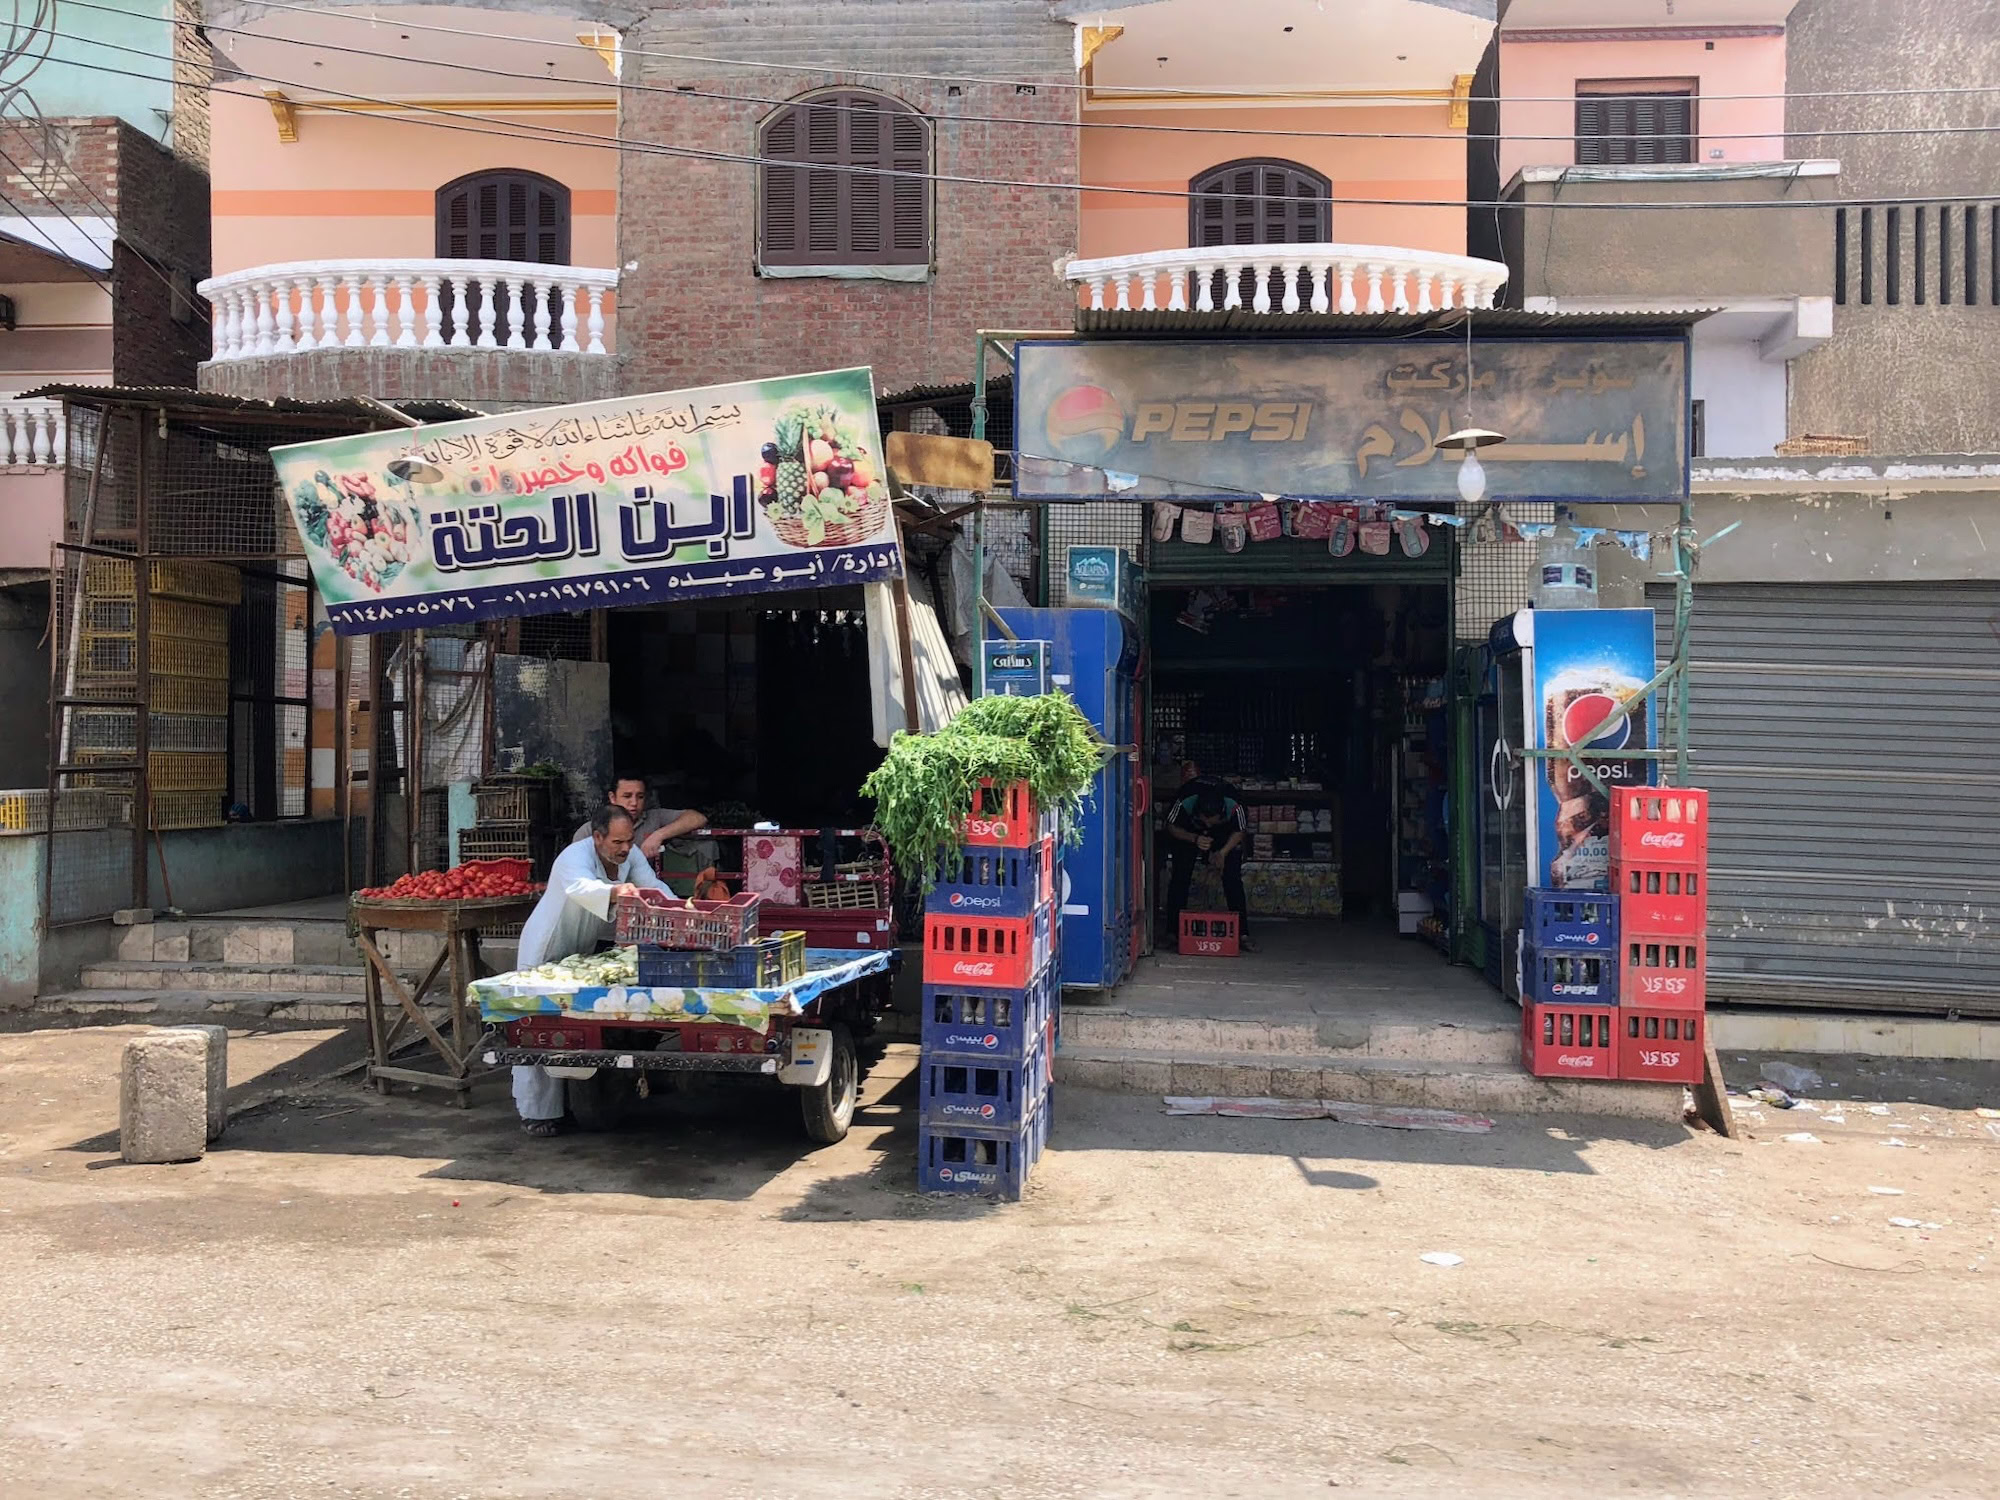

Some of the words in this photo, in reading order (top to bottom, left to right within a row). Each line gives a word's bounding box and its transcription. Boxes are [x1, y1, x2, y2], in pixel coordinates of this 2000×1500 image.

[650, 403, 699, 432] الله
[682, 403, 742, 434] بسم
[1131, 402, 1314, 442] PEPSI
[545, 416, 583, 448] الله
[609, 440, 688, 477] فواكه
[618, 474, 756, 559] ابن
[430, 491, 598, 572] الحتة
[770, 554, 824, 582] أبو
[504, 576, 651, 604] ٠١٠٠١٩٧٩١٠٦
[332, 595, 476, 623] ٠١١٤٨٠٠٥٠٧٦
[1641, 831, 1685, 848] Coca-Cola
[963, 896, 1001, 909] pepsi
[953, 961, 995, 977] Coca-Cola
[1563, 985, 1598, 995] PEPSI
[1558, 1054, 1594, 1068] Coca-Cola
